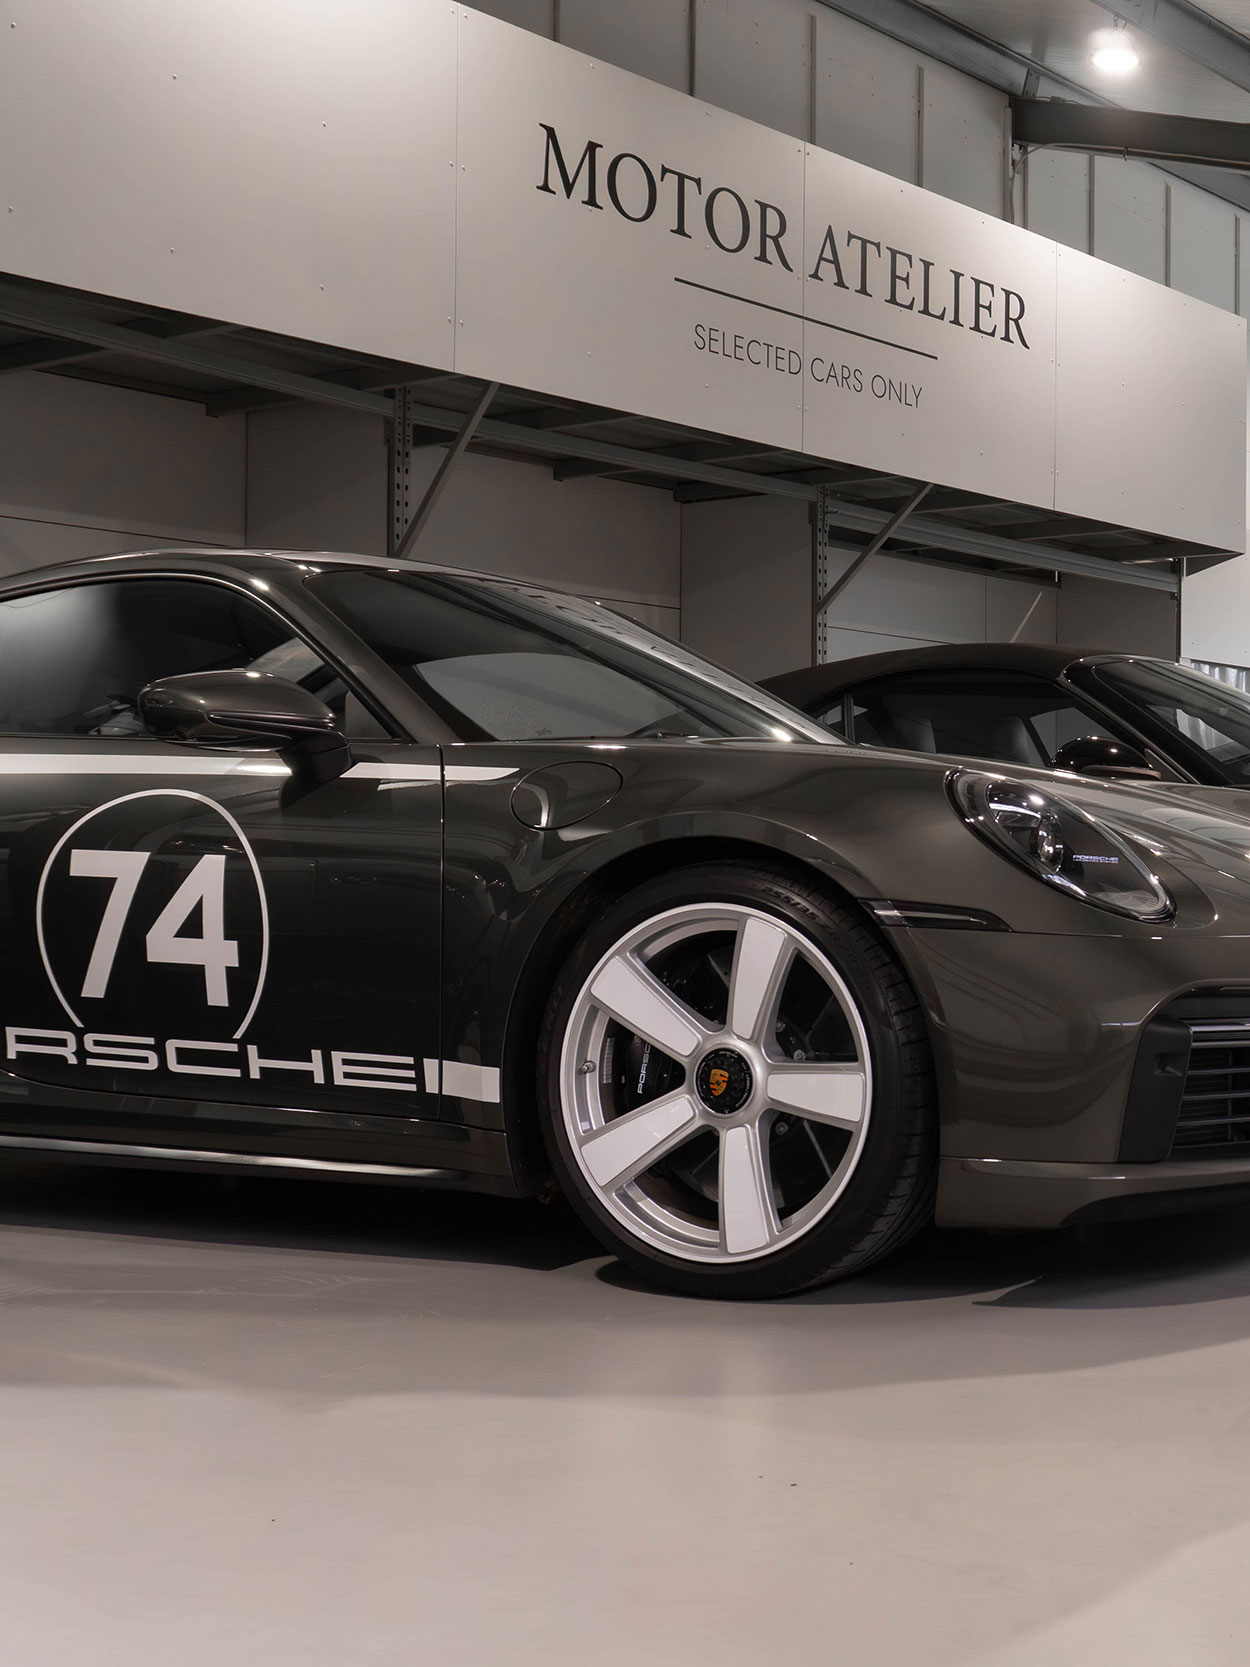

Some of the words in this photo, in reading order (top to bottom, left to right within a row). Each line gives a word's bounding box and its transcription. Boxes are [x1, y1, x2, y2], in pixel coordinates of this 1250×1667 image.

[535, 122, 794, 273] MOTOR
[808, 224, 1031, 351] ATELIER
[693, 323, 802, 376] SELECTED
[810, 357, 864, 393] CARS
[870, 374, 923, 409] ONLY
[69, 848, 239, 1007] 74
